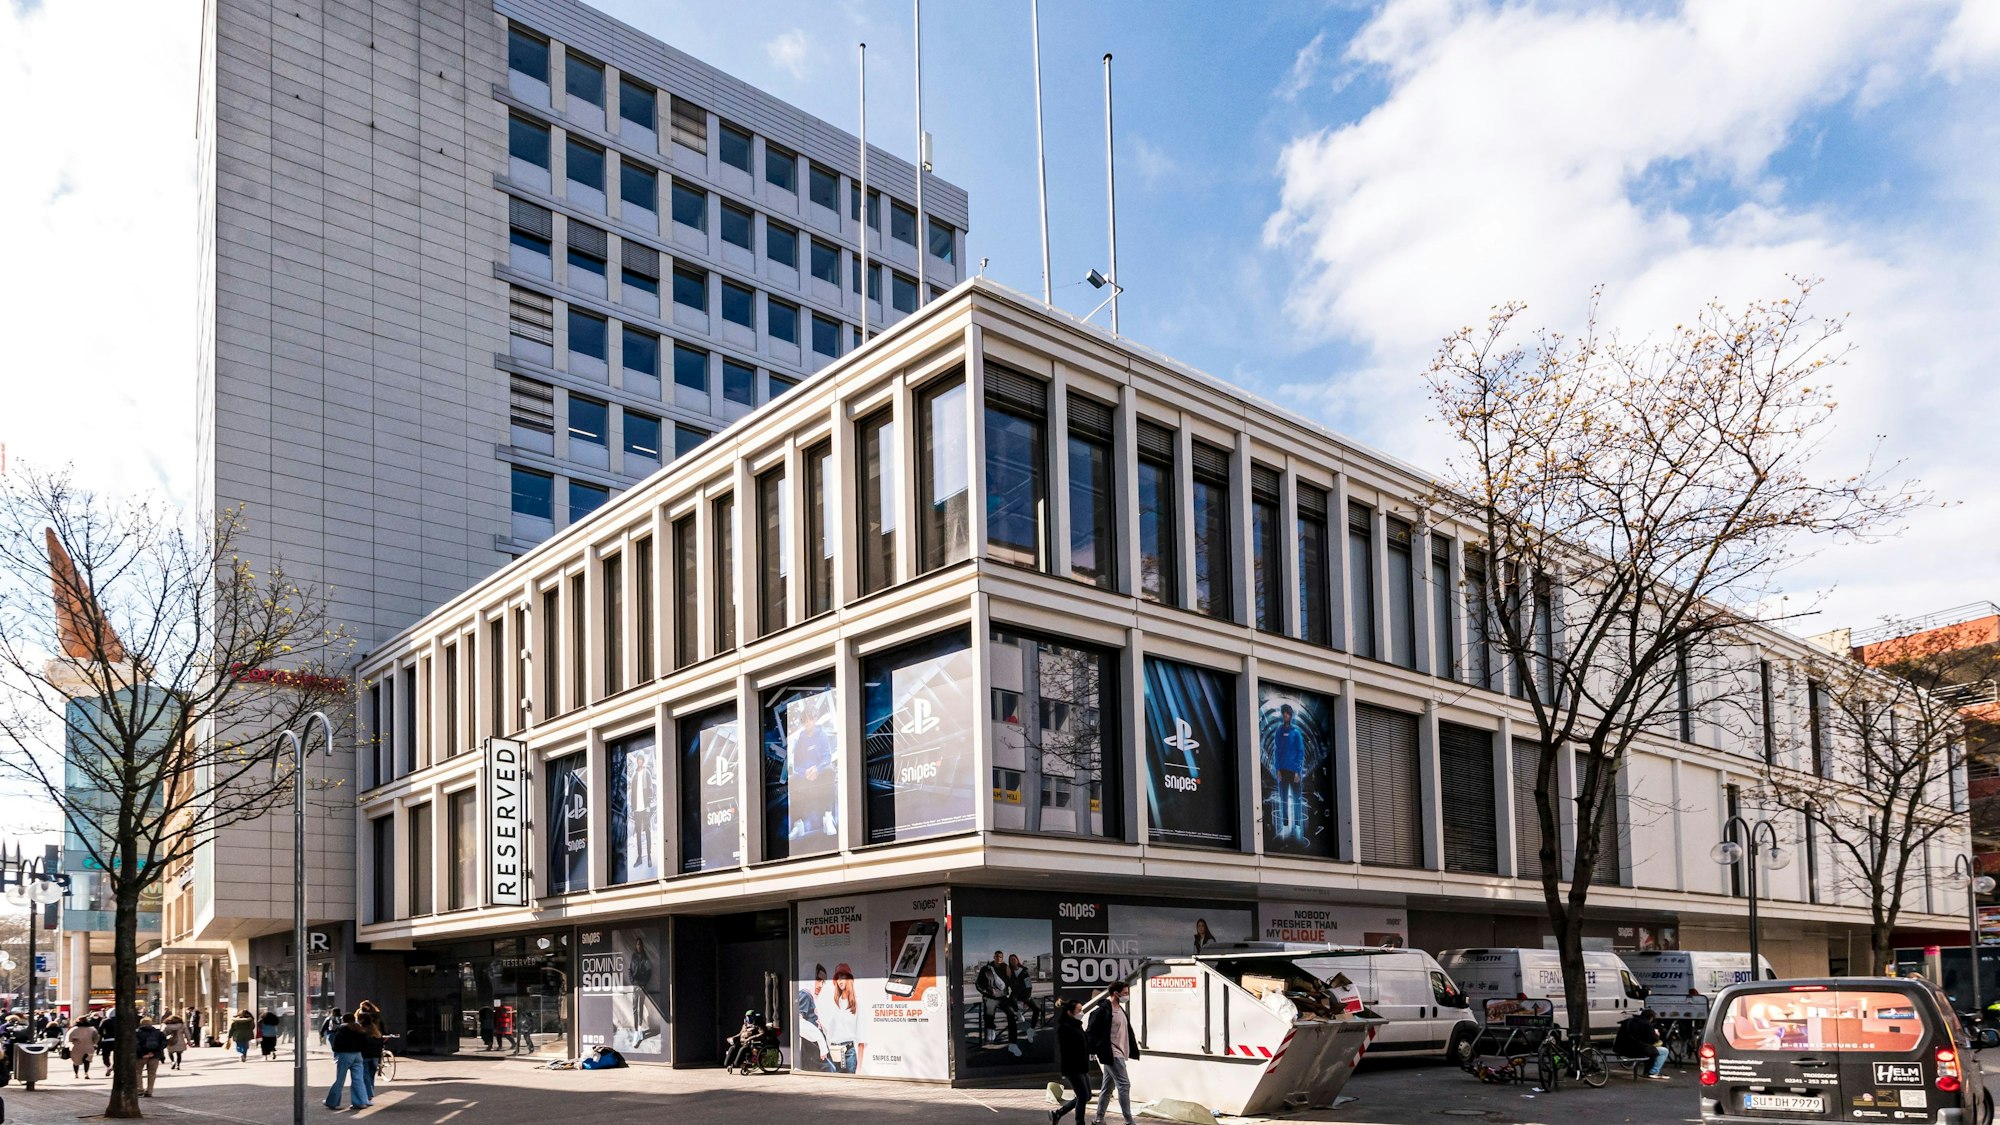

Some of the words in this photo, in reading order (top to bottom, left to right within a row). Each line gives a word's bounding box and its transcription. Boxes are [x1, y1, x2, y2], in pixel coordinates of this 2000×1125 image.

[901, 761, 937, 783] snipes
[1164, 774, 1198, 792] snipes
[497, 749, 516, 895] RESERVED
[707, 809, 732, 826] snipes
[568, 837, 586, 852] snipes
[823, 905, 856, 915] NOBODY
[913, 899, 936, 911] snipes
[1059, 902, 1096, 920] snipes
[805, 915, 839, 926] FRESHER
[841, 913, 862, 922] THAN
[1294, 910, 1331, 920] NOBODY
[801, 926, 813, 934] MY
[813, 923, 850, 936] CLIQUE
[1272, 919, 1312, 929] FRESHER
[1315, 920, 1338, 930] THAN
[581, 931, 601, 946] snipes
[1266, 928, 1281, 938] MY
[1281, 929, 1326, 942] CLIQUE
[1060, 938, 1139, 955] COMING
[502, 957, 536, 967] RESERVED
[582, 956, 624, 973] COMING
[1061, 958, 1140, 983] SOON
[582, 972, 624, 992] SOON
[874, 1009, 904, 1017] SNIPES
[906, 1009, 923, 1017] APP
[872, 1054, 902, 1062] SNIPES.COM
[1877, 1064, 1919, 1083] HELM
[1753, 1096, 1767, 1106] SU
[1775, 1097, 1789, 1107] DH
[1791, 1098, 1820, 1109] 7979
